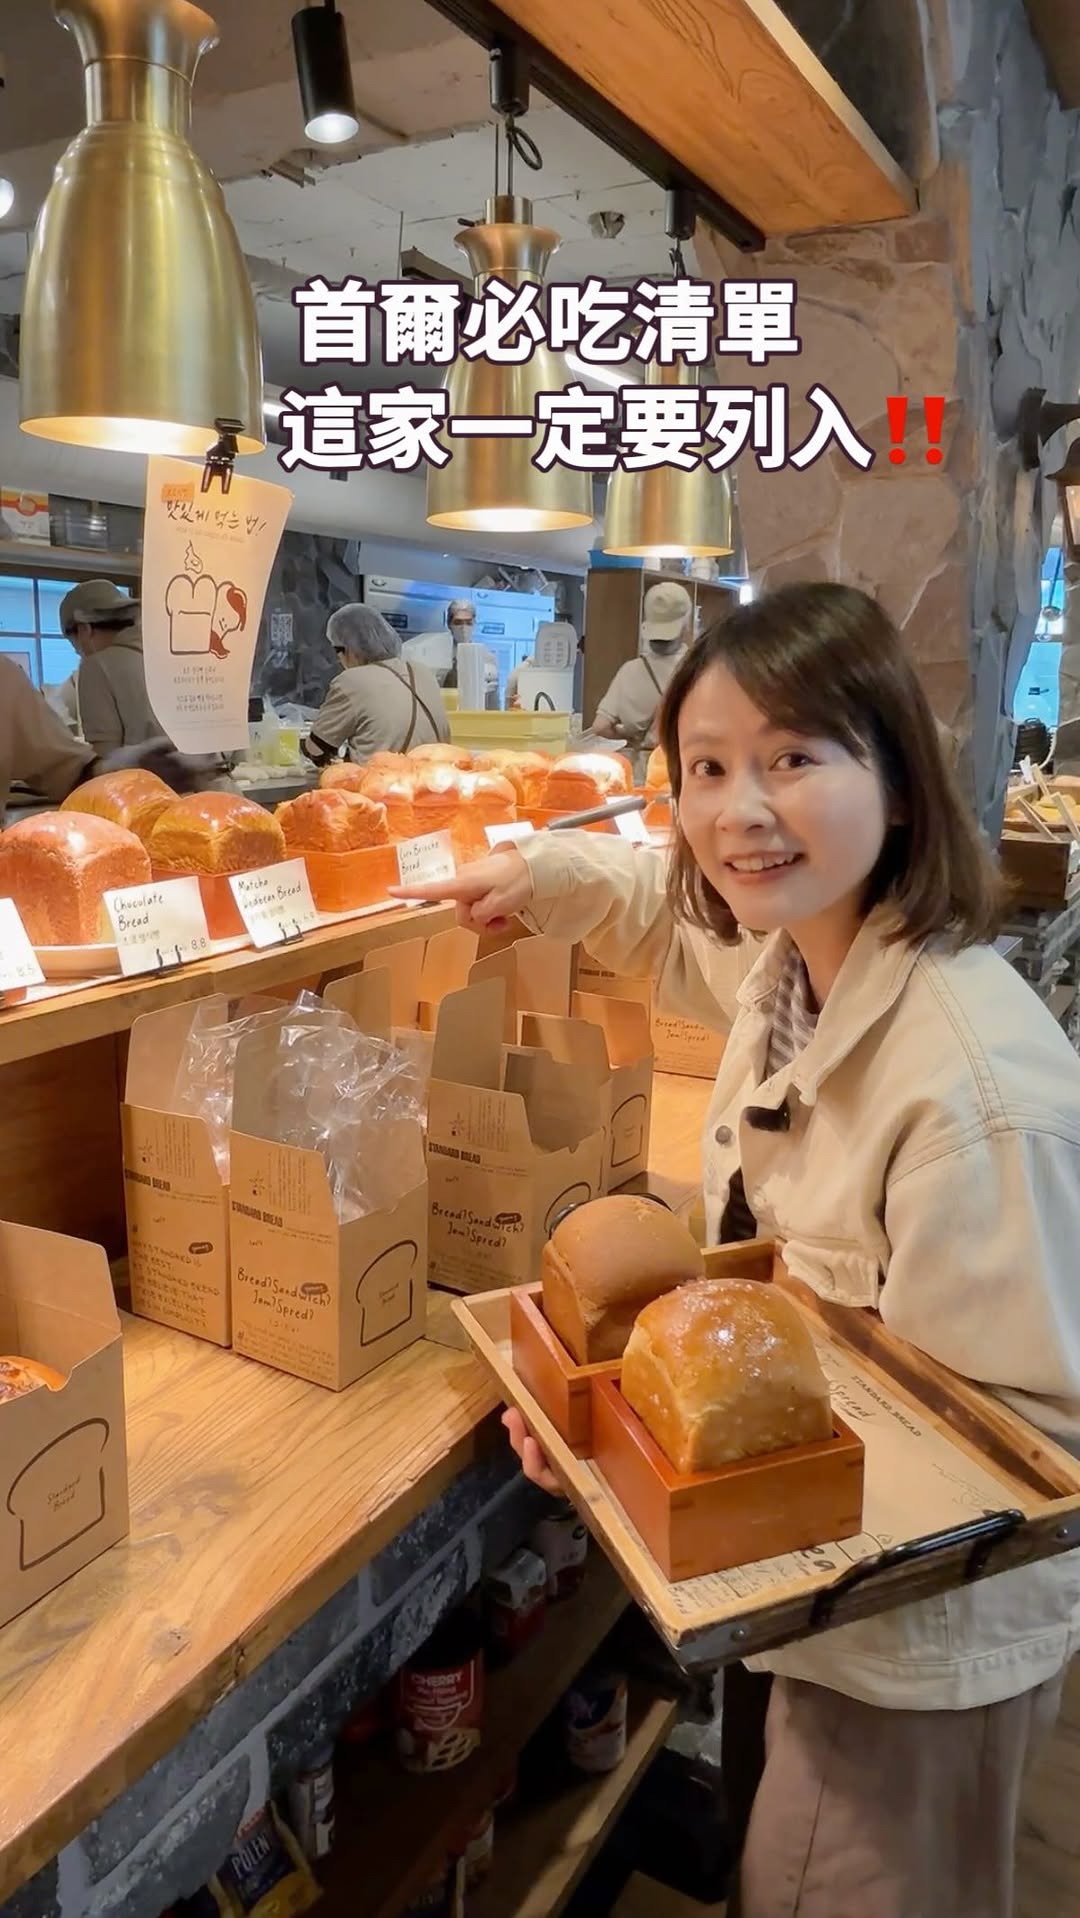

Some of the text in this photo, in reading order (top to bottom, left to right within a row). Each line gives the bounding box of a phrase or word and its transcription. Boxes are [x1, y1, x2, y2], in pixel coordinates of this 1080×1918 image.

[214, 510, 240, 530] 먹는
[276, 881, 303, 900] Bread
[113, 893, 164, 914] Chocolate
[118, 916, 150, 932] Bread
[411, 1670, 462, 1688] CHERRY
